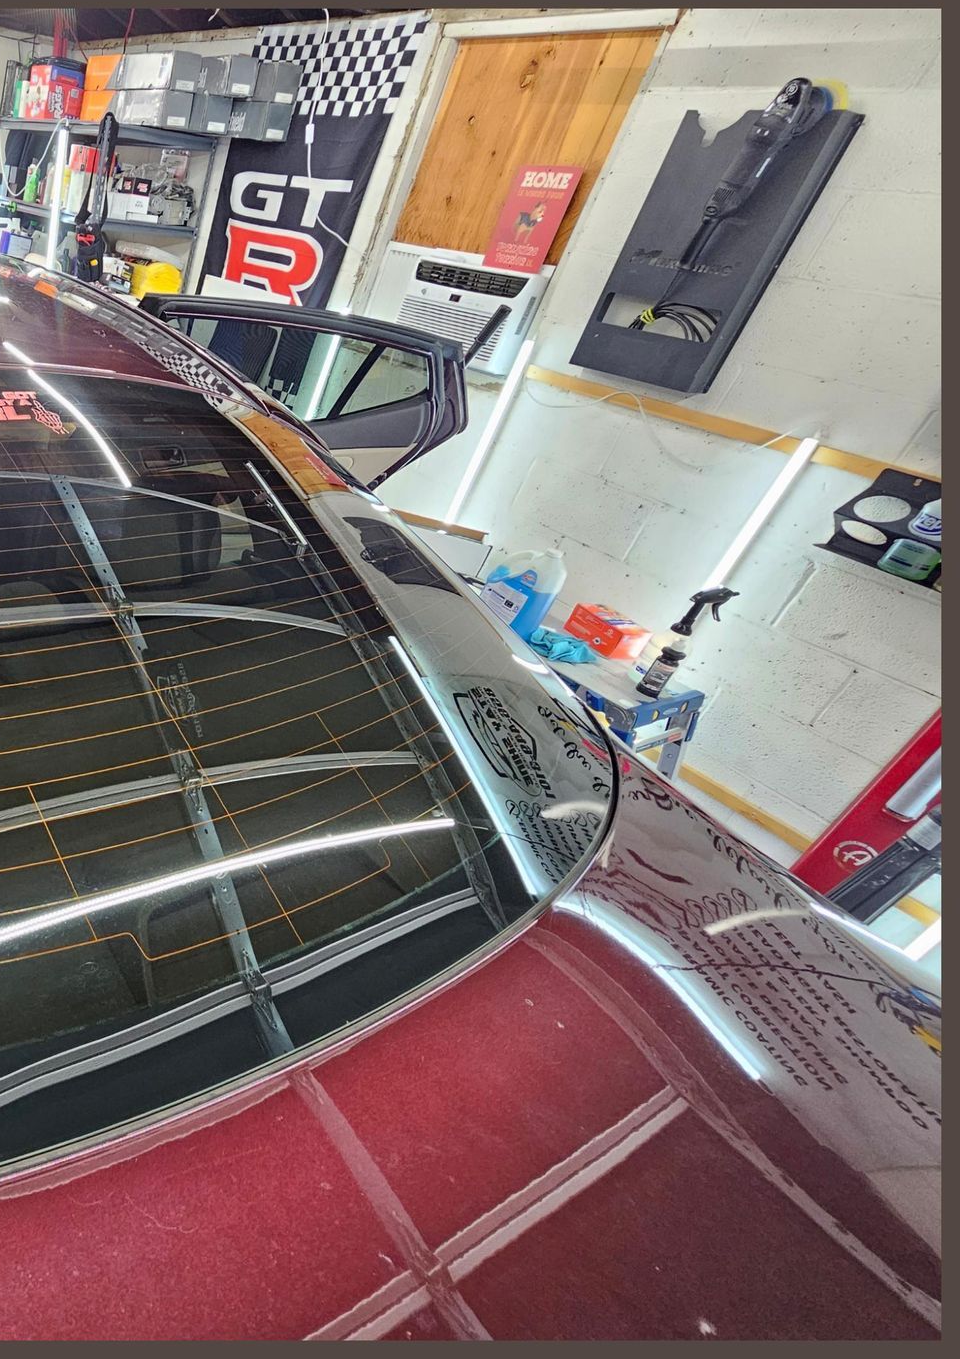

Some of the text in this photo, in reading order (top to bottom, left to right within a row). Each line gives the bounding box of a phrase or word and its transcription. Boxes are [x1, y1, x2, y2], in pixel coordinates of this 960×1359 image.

[230, 170, 354, 228] GT
[520, 170, 575, 191] HOME
[225, 217, 324, 307] R
[1, 391, 38, 400] GOT
